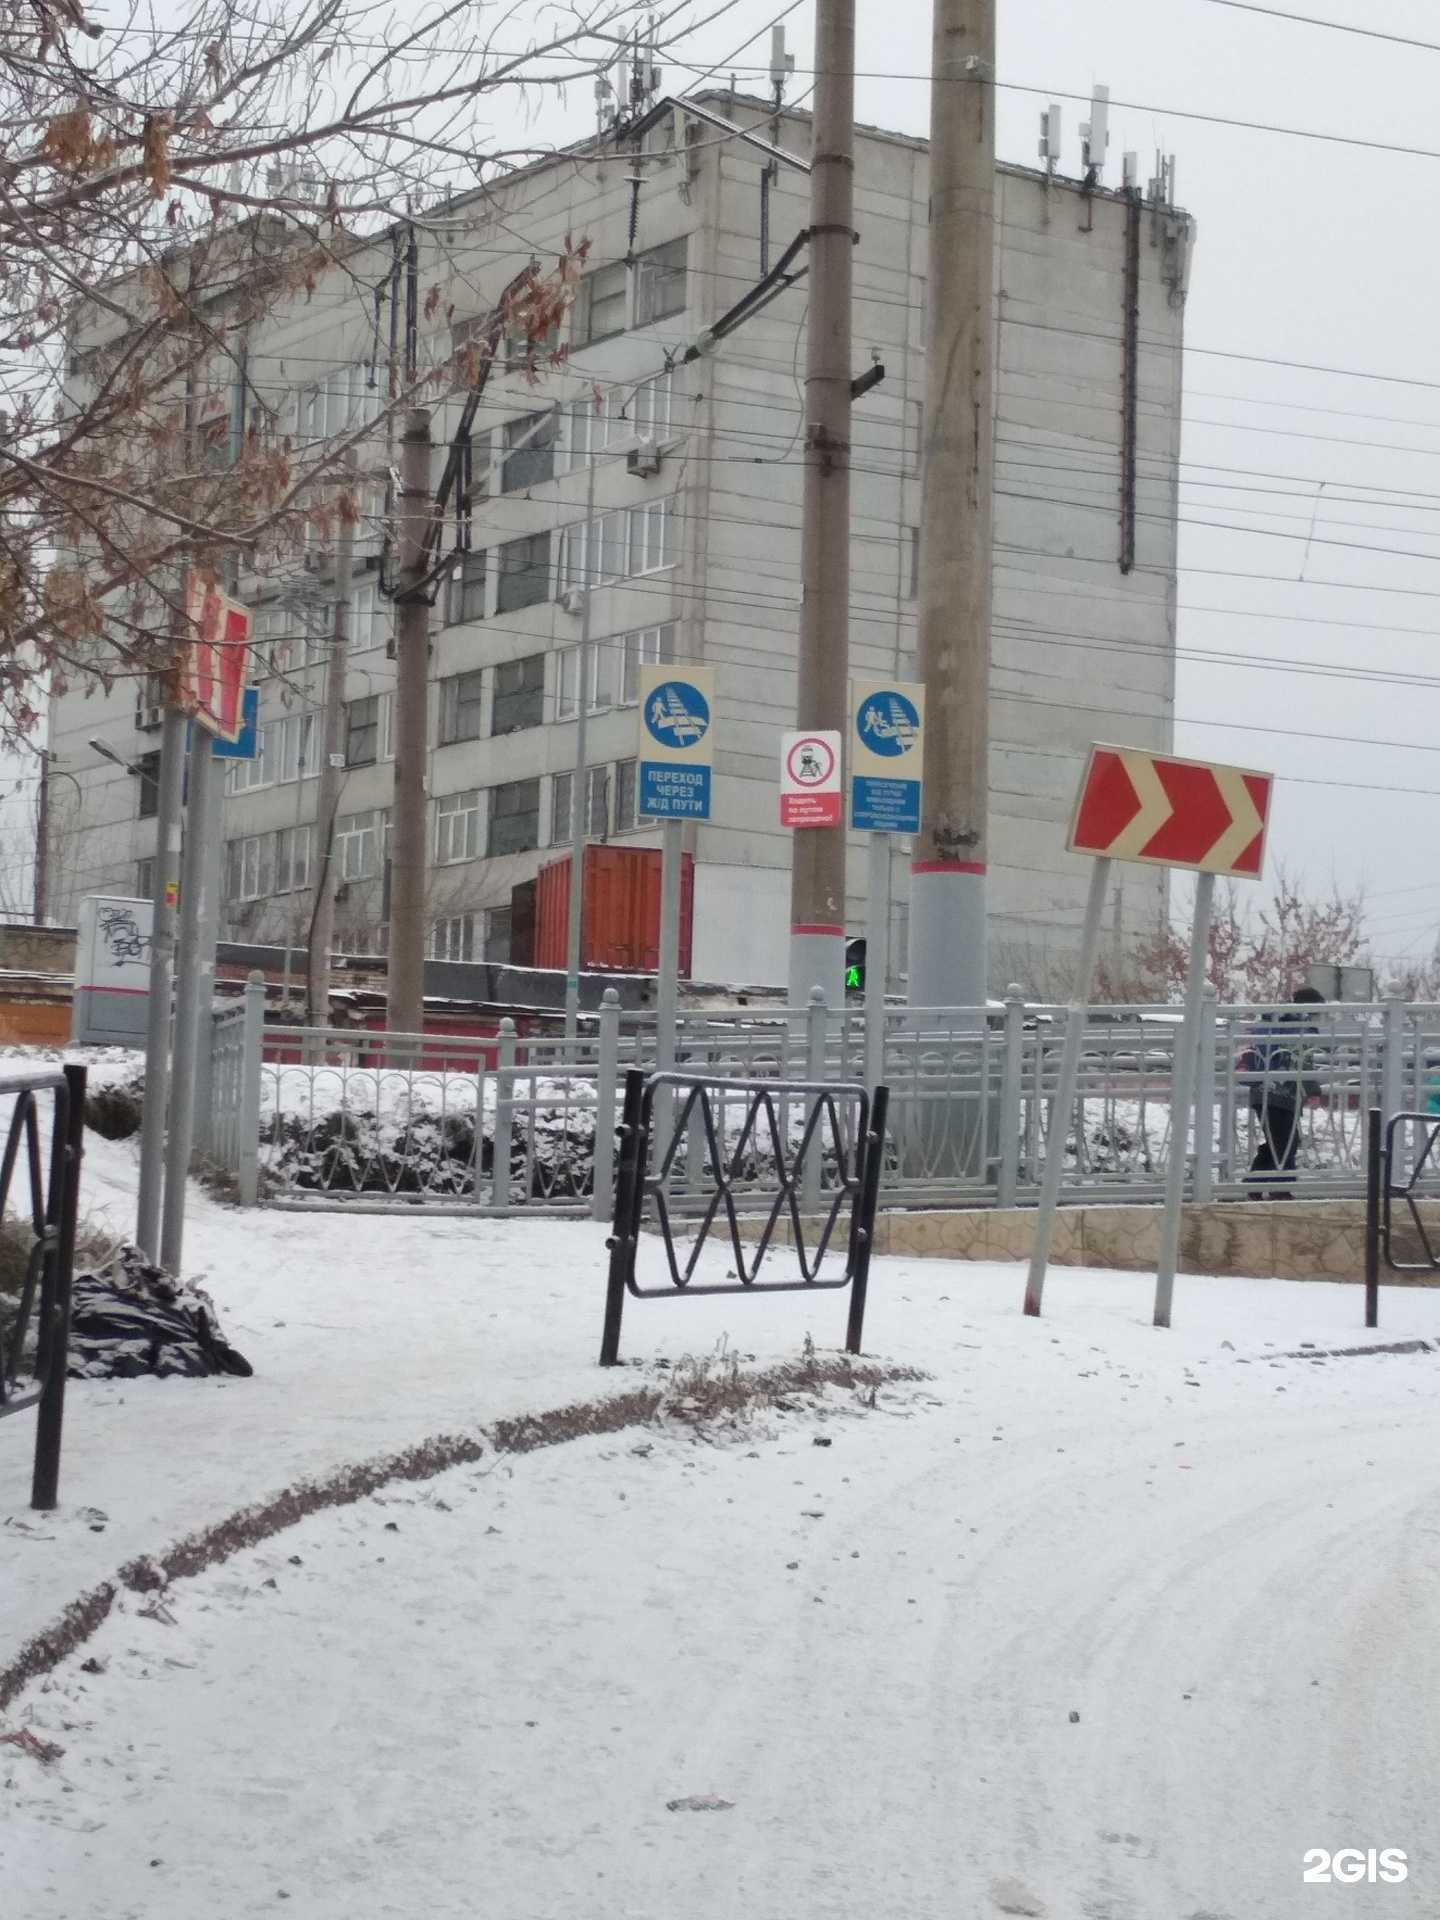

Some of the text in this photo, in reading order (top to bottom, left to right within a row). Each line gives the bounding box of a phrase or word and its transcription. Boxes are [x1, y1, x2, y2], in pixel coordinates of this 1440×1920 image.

[648, 770, 704, 786] ПЕРЕХОД
[656, 784, 695, 798] ЧЕРЕЗ
[672, 798, 703, 812] ПУТИ
